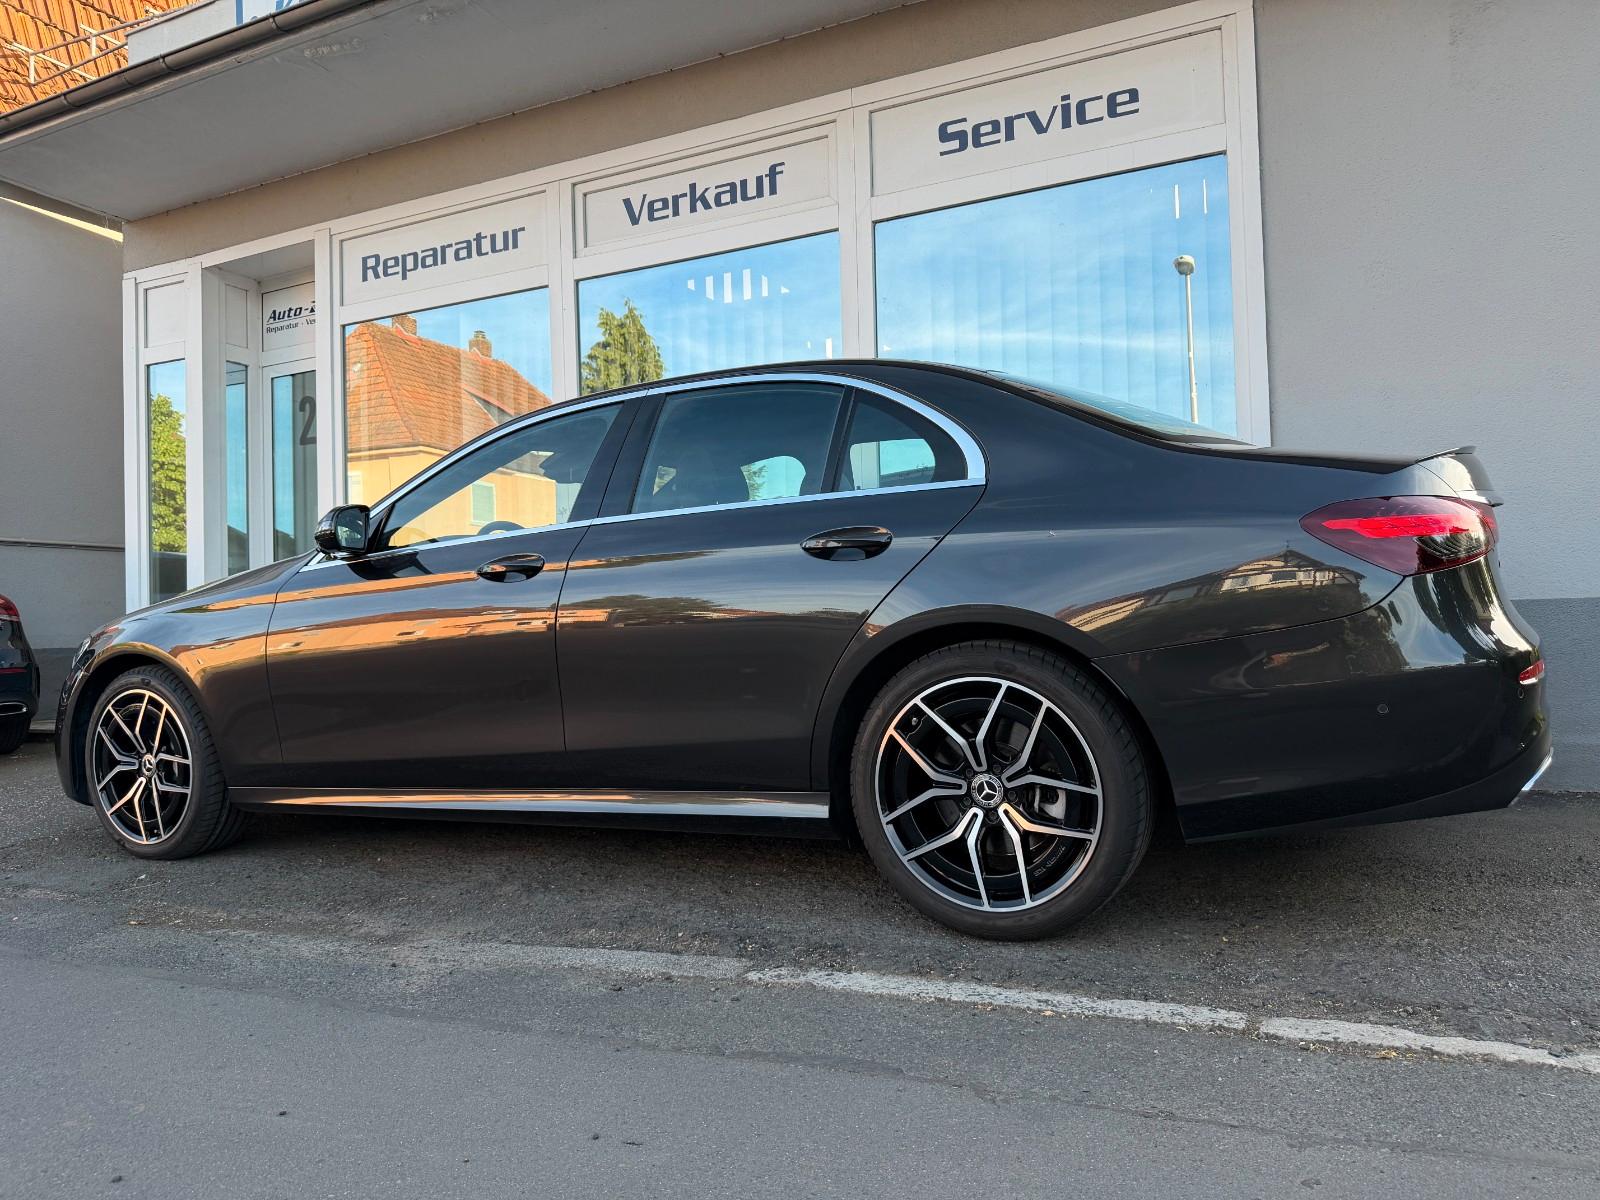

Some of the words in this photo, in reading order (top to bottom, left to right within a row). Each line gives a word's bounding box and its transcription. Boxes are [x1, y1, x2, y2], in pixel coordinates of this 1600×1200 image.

[938, 87, 1140, 157] Service
[622, 161, 786, 227] Verkauf
[361, 226, 526, 283] Reparatur
[266, 321, 299, 334] Reparatur
